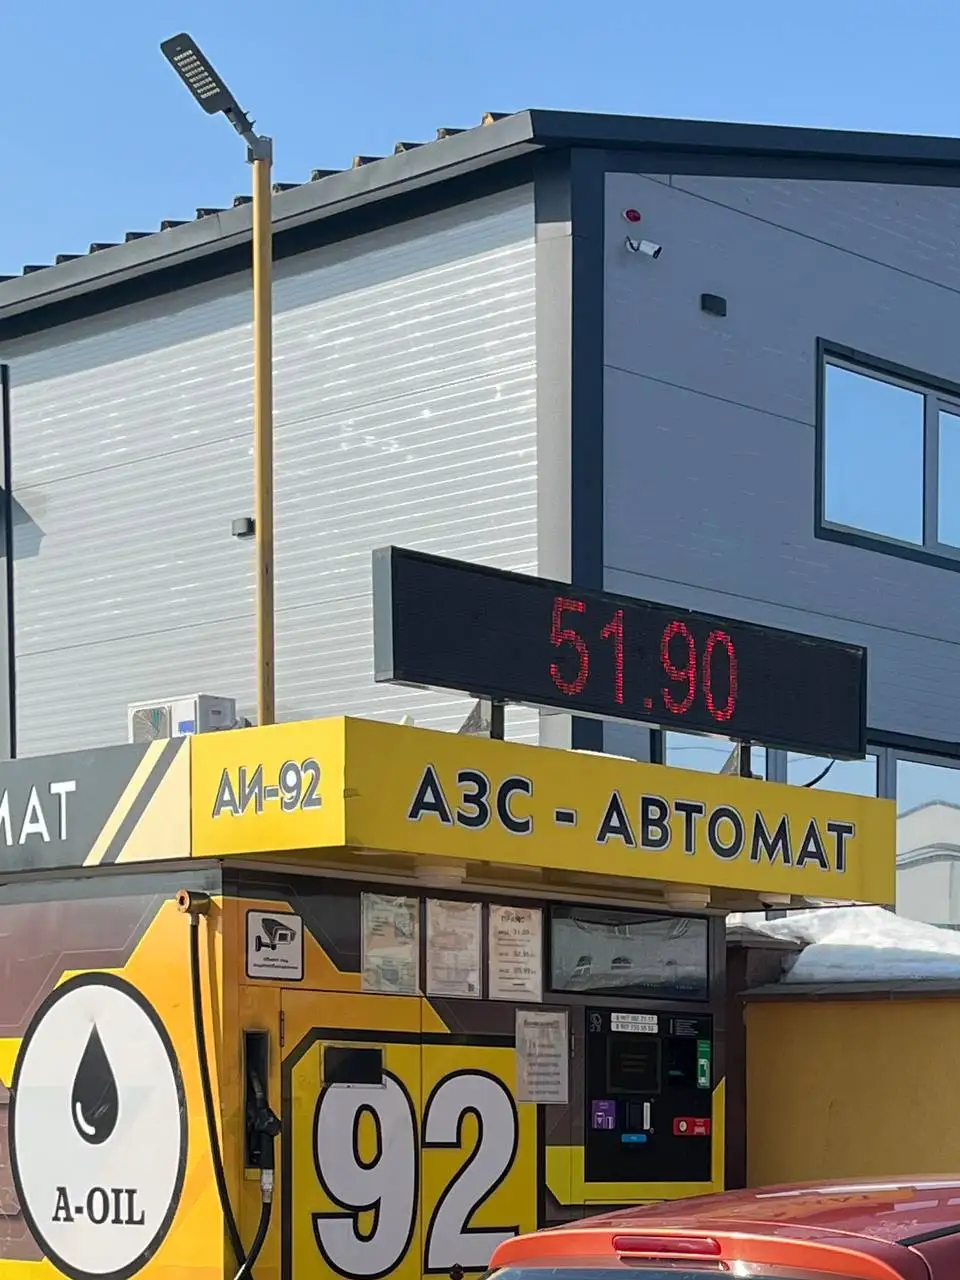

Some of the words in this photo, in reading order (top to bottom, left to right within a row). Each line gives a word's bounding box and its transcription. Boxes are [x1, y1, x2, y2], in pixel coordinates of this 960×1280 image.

[550, 597, 738, 721] 51.90
[212, 757, 322, 818] АИ-92
[408, 763, 534, 836] АЗС
[596, 789, 855, 873] АВТОМАТ
[52, 1186, 145, 1226] A-OIL
[312, 1068, 520, 1280] 92
